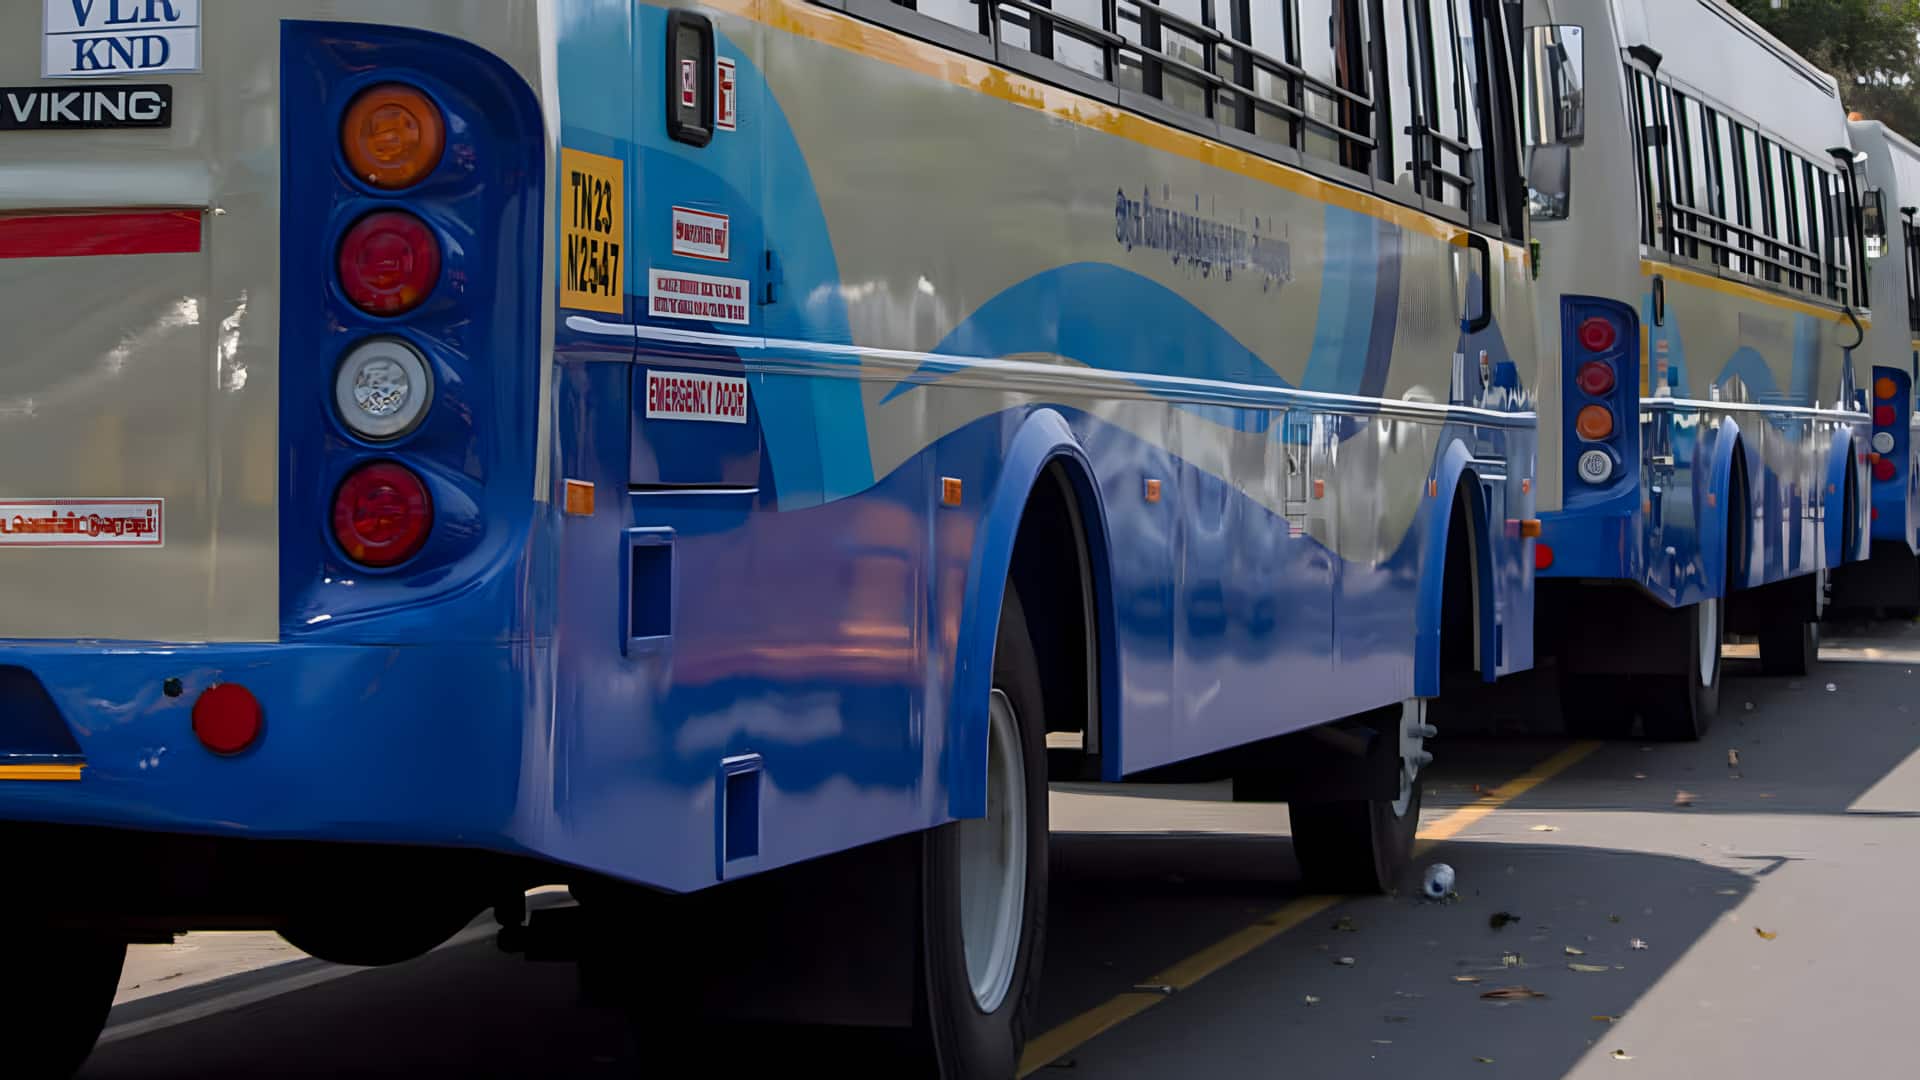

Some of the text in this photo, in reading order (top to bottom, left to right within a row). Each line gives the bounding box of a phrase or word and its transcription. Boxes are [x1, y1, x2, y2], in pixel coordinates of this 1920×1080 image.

[70, 34, 170, 72] KND
[7, 90, 162, 123] VIKING
[571, 170, 613, 235] TN23
[649, 376, 745, 417] EMERGENCY DOOR
